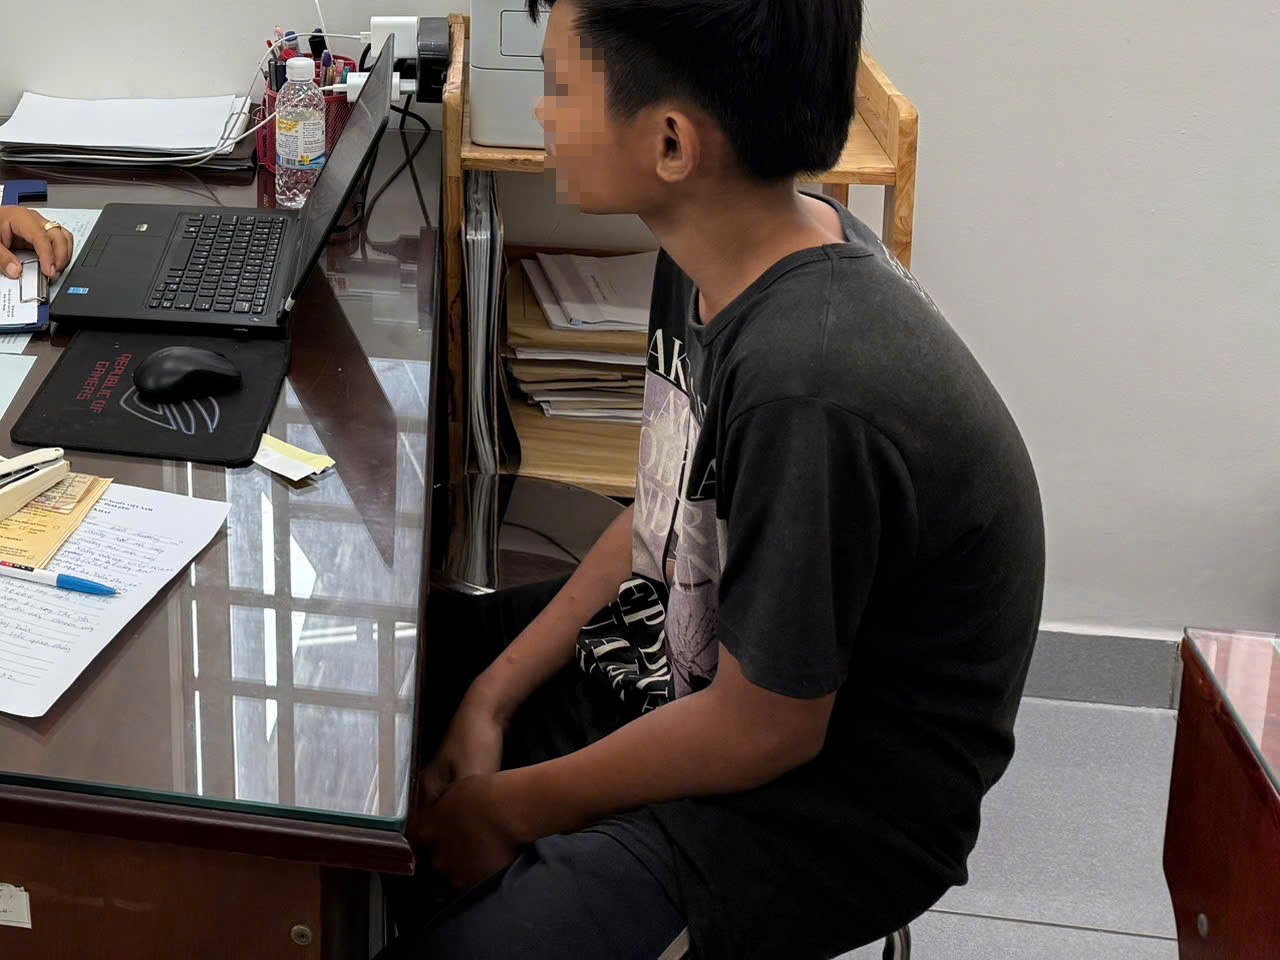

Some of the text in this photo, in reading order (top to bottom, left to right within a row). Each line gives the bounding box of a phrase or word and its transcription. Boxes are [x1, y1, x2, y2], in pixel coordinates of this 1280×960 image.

[76, 360, 110, 400] GAMERS
[90, 353, 132, 414] REPUBLIC OF
